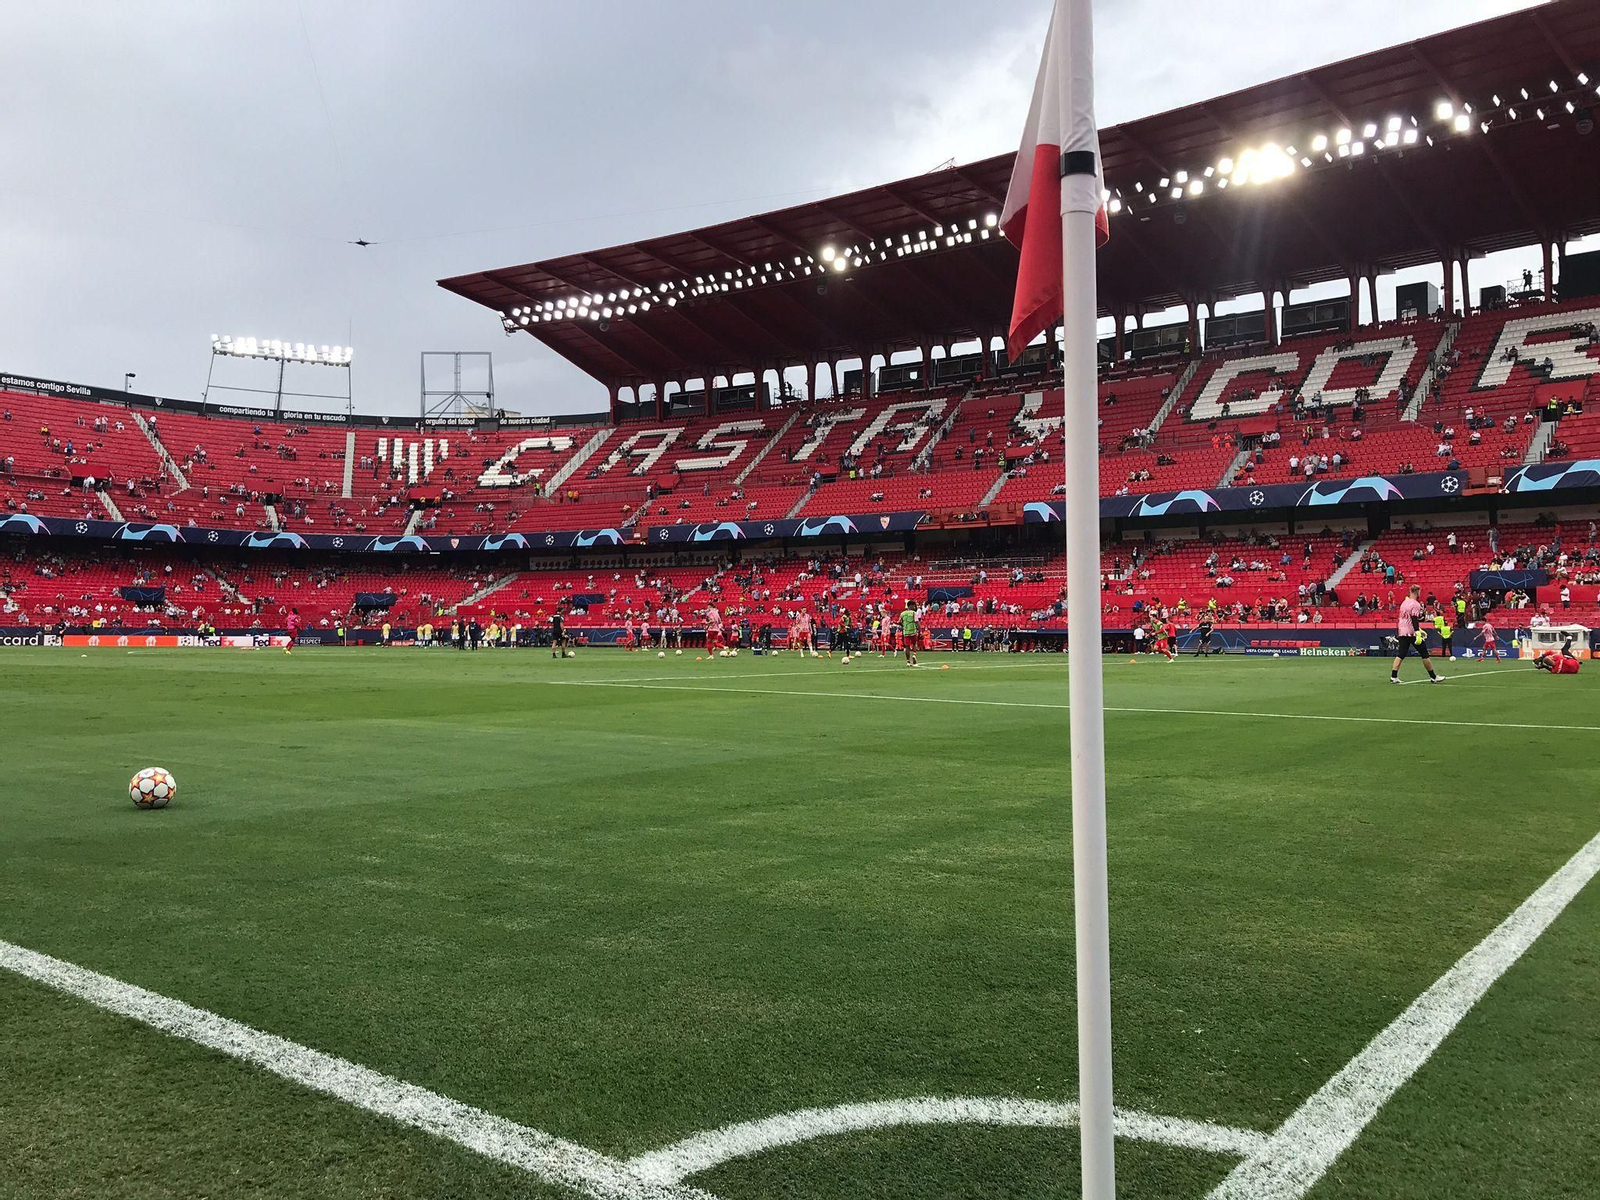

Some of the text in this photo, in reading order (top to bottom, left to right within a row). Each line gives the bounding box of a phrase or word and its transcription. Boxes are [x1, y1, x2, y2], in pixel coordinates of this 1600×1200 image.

[1, 376, 91, 395] estamos contigo Sevilla
[219, 405, 266, 416] compartiendo
[267, 409, 274, 417] la
[283, 411, 303, 419] gloria
[322, 413, 346, 421] escudo
[425, 418, 446, 426] orgullo
[447, 417, 457, 425] del
[500, 417, 508, 425] de
[531, 416, 550, 424] ciudad
[203, 636, 235, 647] FedEx
[253, 636, 282, 647] FedEx
[1300, 647, 1346, 656] Heineken
